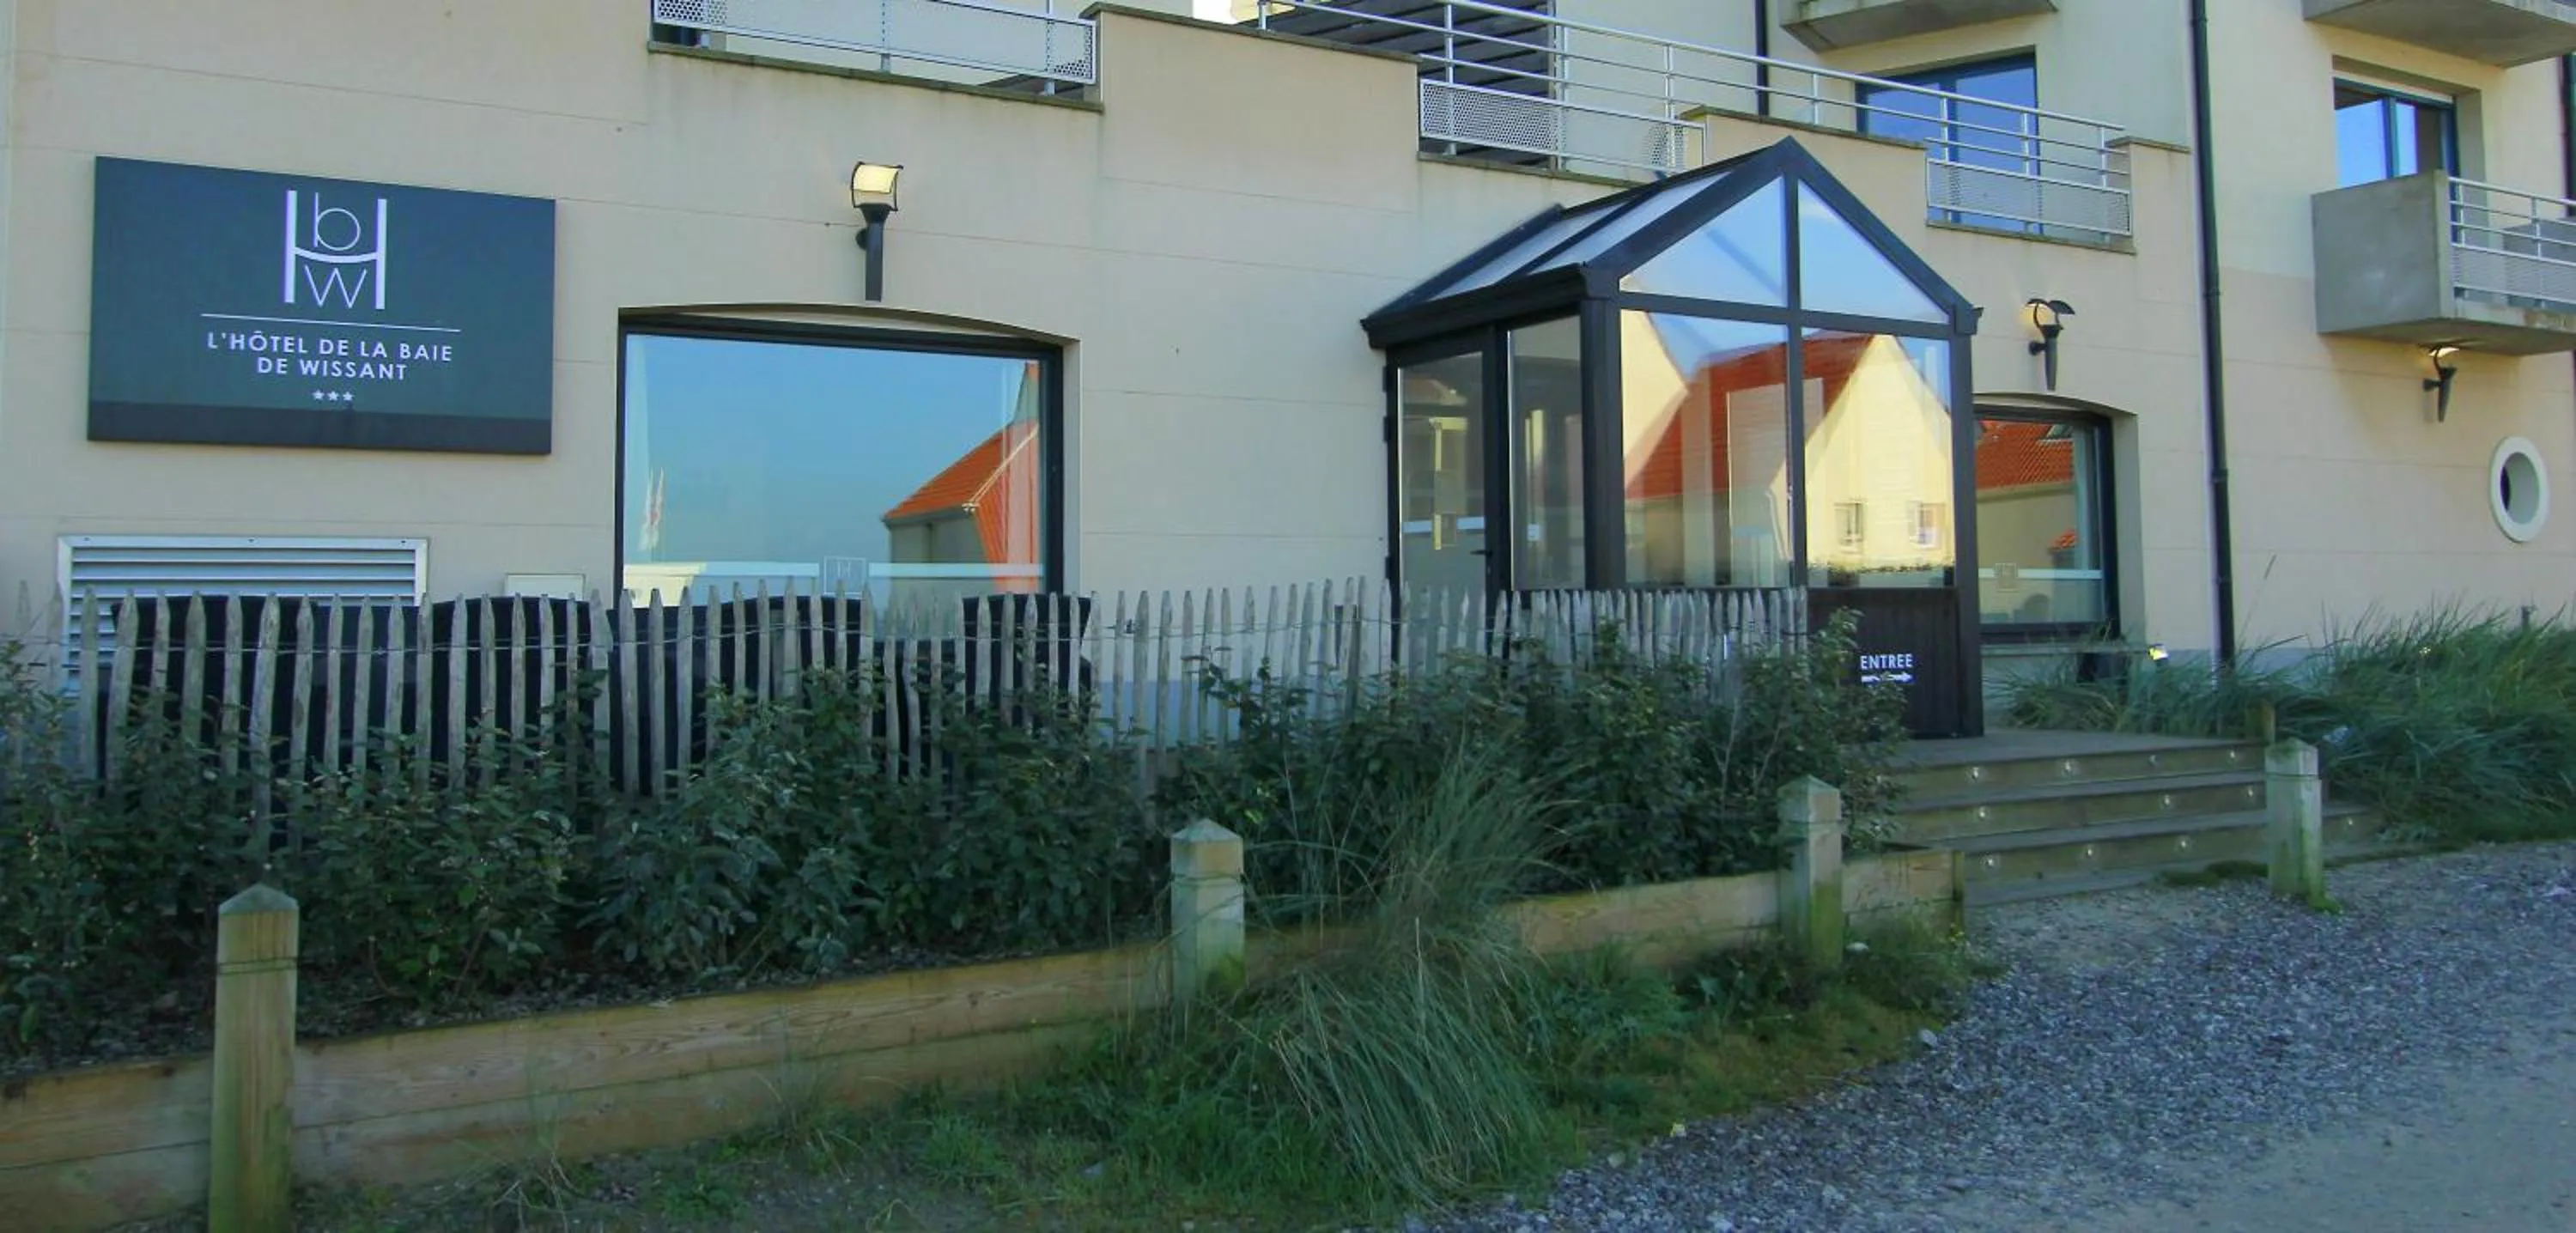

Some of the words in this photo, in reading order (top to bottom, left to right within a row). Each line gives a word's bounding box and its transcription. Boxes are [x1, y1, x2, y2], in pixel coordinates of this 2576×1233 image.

[207, 331, 308, 354] L'HÔTEL
[319, 338, 349, 356] DE
[360, 341, 387, 358] LA
[399, 343, 453, 361] BAIE
[258, 356, 288, 374] DE
[299, 359, 408, 380] WISSANT
[1860, 653, 1914, 670] ENTREE
